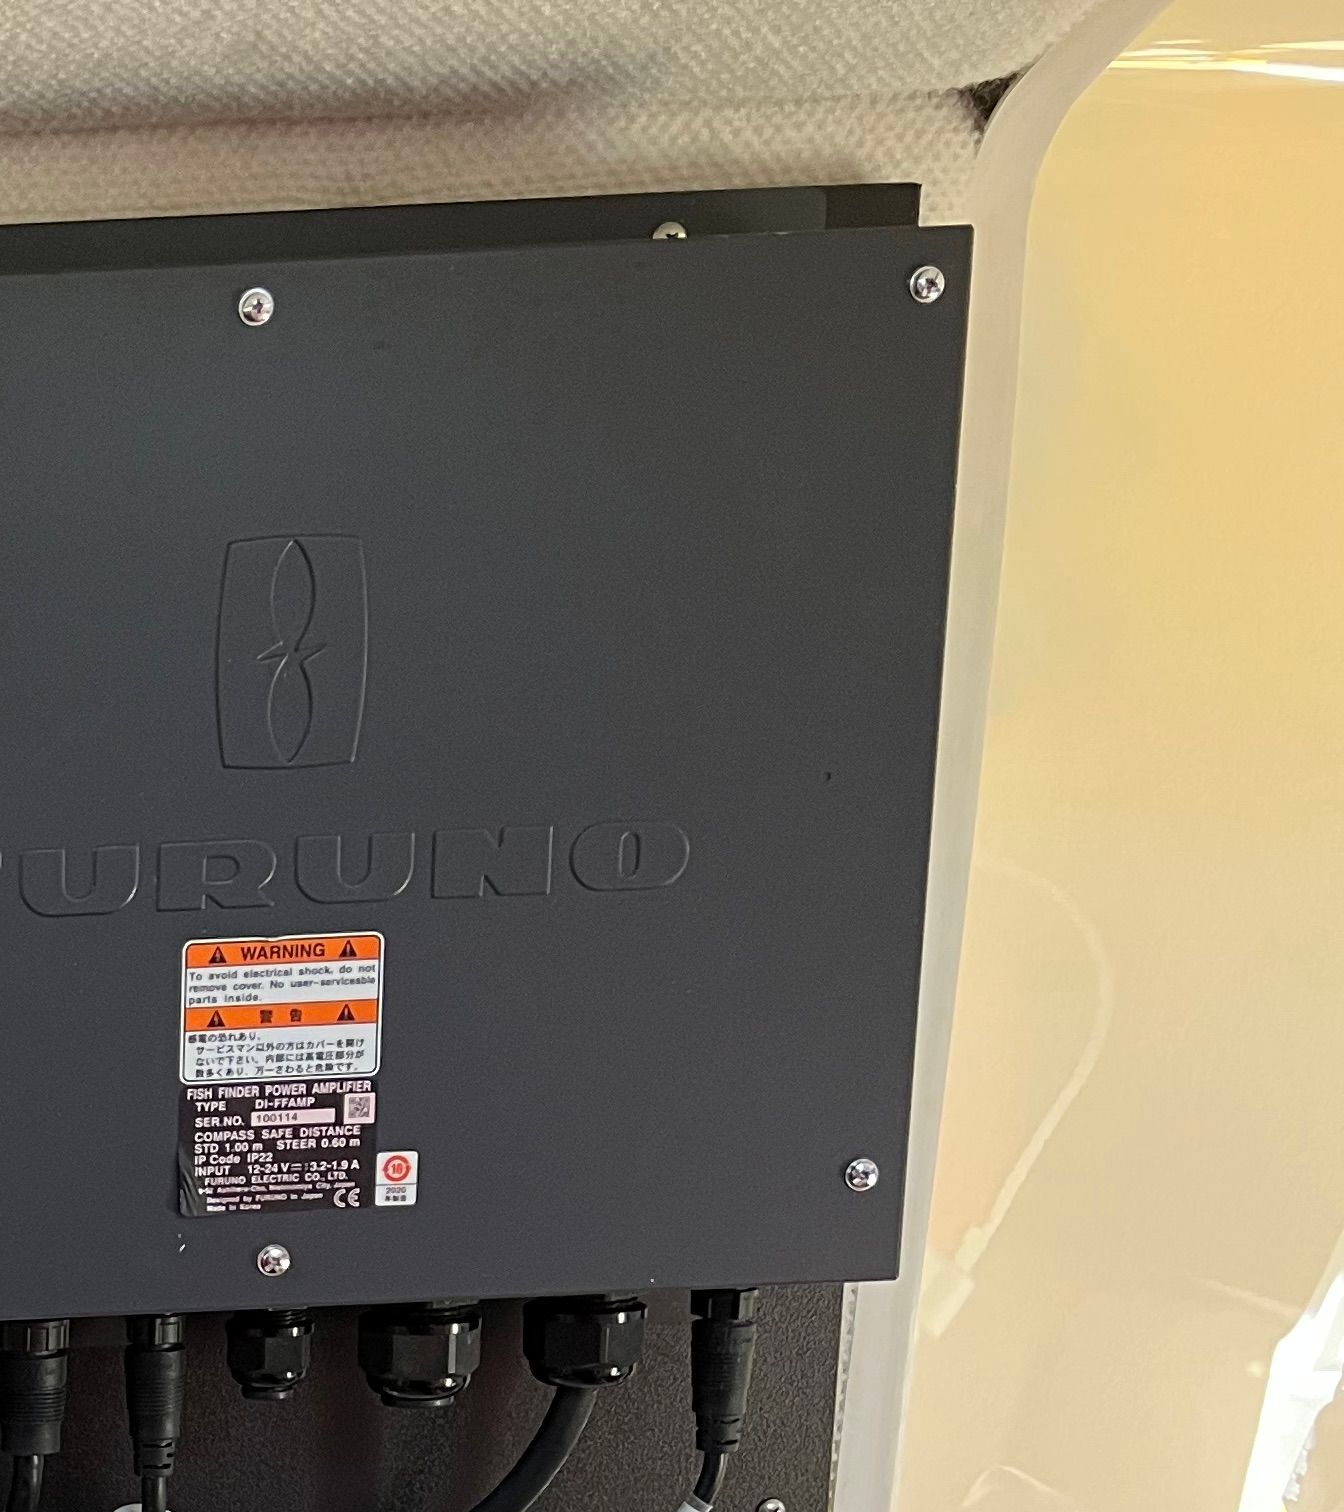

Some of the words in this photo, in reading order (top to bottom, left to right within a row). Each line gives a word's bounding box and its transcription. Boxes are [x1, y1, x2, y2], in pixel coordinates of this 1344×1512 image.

[240, 943, 325, 961] WARNING
[189, 971, 203, 981] To
[208, 969, 238, 980] avoid
[243, 967, 293, 979] electrical
[339, 964, 353, 974] do
[358, 963, 376, 974] not
[189, 982, 227, 993] remove
[270, 980, 284, 989] No
[188, 994, 217, 1006] parts
[223, 993, 262, 1004] inside.
[186, 1086, 213, 1100] FISH
[218, 1084, 259, 1099] FINDER
[264, 1082, 307, 1097] POWER
[311, 1080, 372, 1094] AMPLIFIER
[195, 1102, 226, 1112] TYPE
[255, 1097, 315, 1110] DI-FFAMP
[255, 1111, 298, 1124] 100114
[194, 1129, 255, 1142] COMPASS
[261, 1127, 294, 1140] SAFE
[299, 1125, 361, 1138] DISTANCE
[194, 1143, 219, 1153] STD
[225, 1142, 249, 1153] 1.00
[252, 1142, 263, 1151] m
[276, 1139, 317, 1151] STEER
[320, 1137, 346, 1149] 0.60
[349, 1138, 361, 1147] m
[194, 1155, 207, 1165] IP
[209, 1153, 241, 1164] Code
[247, 1152, 273, 1163] IP22
[194, 1166, 230, 1177] INPUT
[247, 1162, 279, 1175] 12-24
[349, 1159, 360, 1170] A
[204, 1175, 247, 1186] FURUNO
[251, 1172, 300, 1185] ELECTRIC
[327, 1170, 349, 1181] LTD.
